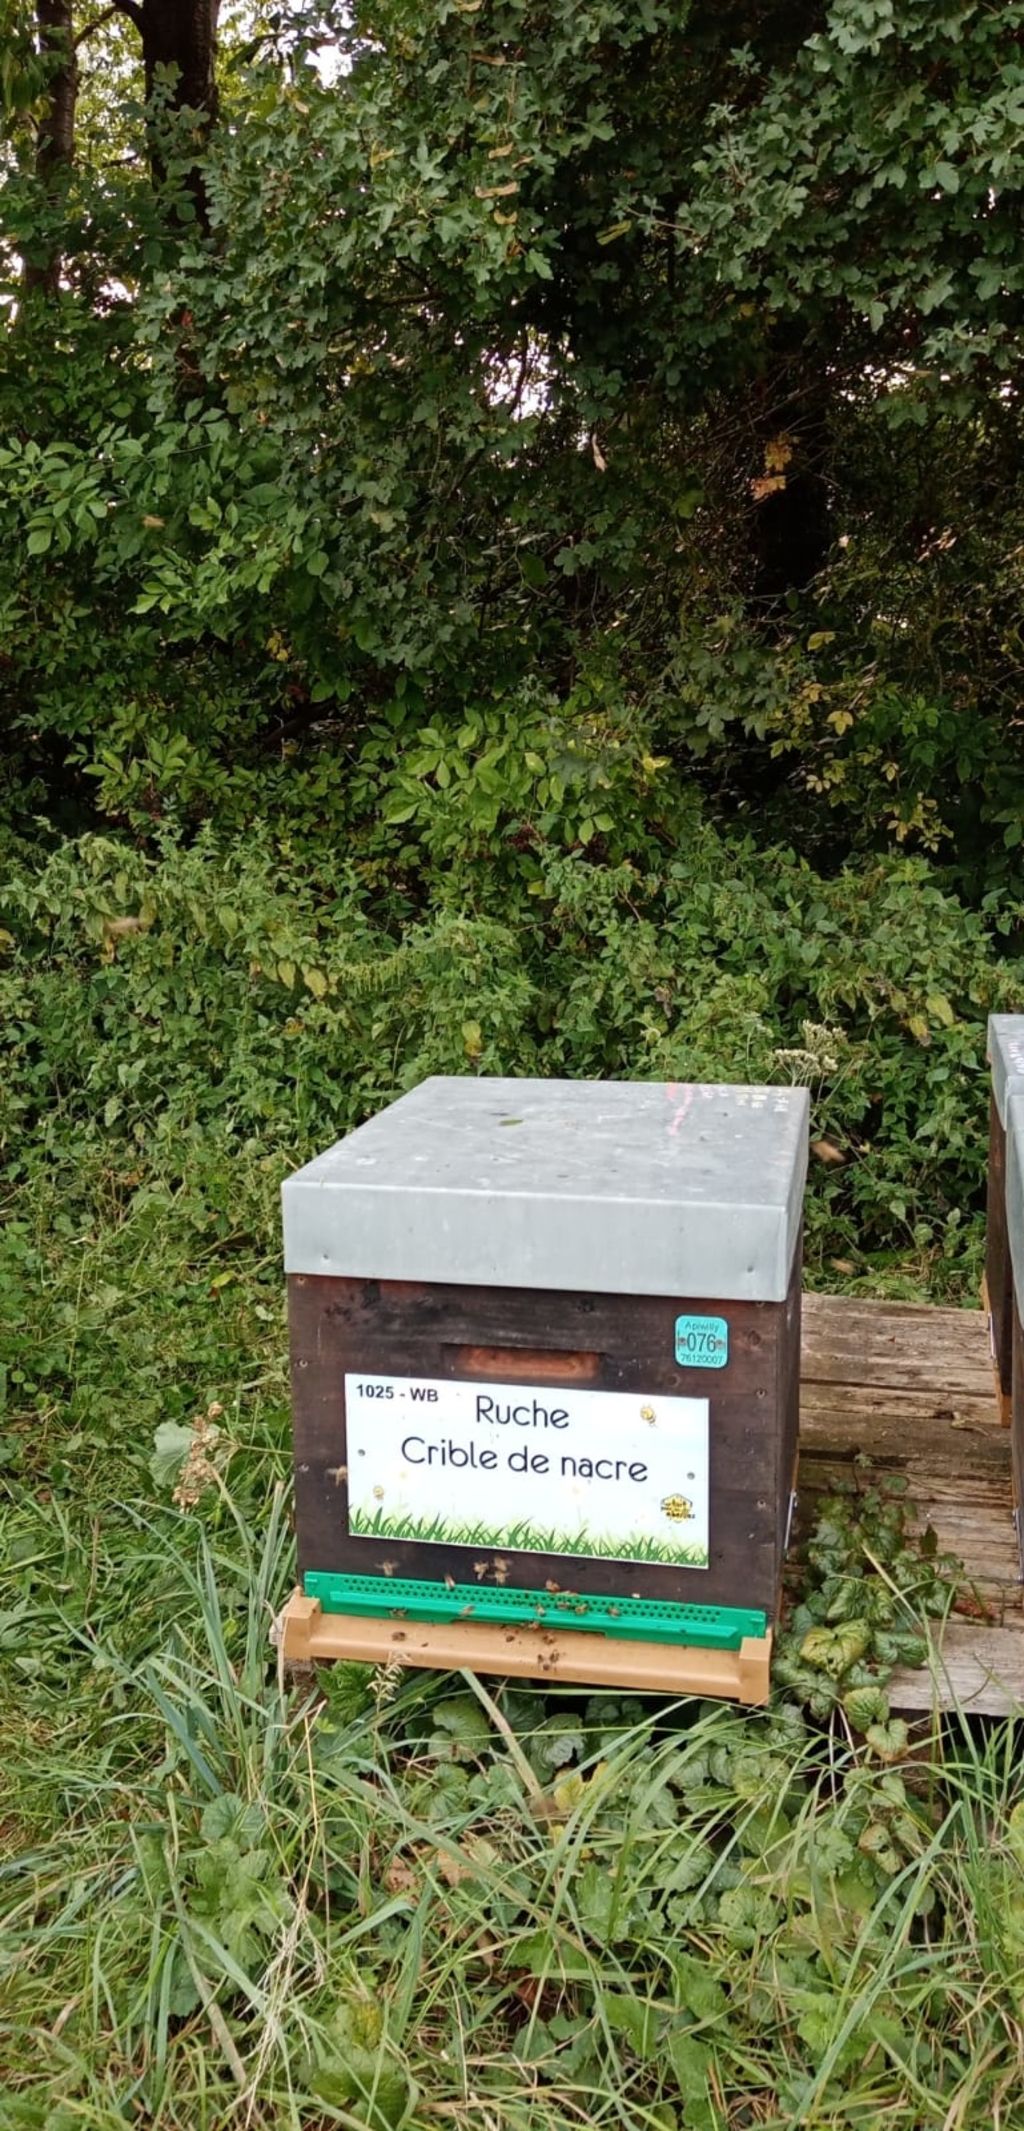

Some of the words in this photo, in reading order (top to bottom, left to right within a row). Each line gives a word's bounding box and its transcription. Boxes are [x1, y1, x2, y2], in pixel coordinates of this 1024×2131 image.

[686, 1331, 717, 1353] 076
[355, 1384, 395, 1400] 1025
[409, 1387, 439, 1403] WB
[475, 1394, 570, 1430] Ruche
[401, 1436, 498, 1471] Crible
[507, 1445, 550, 1475] de
[561, 1454, 649, 1483] nacre
